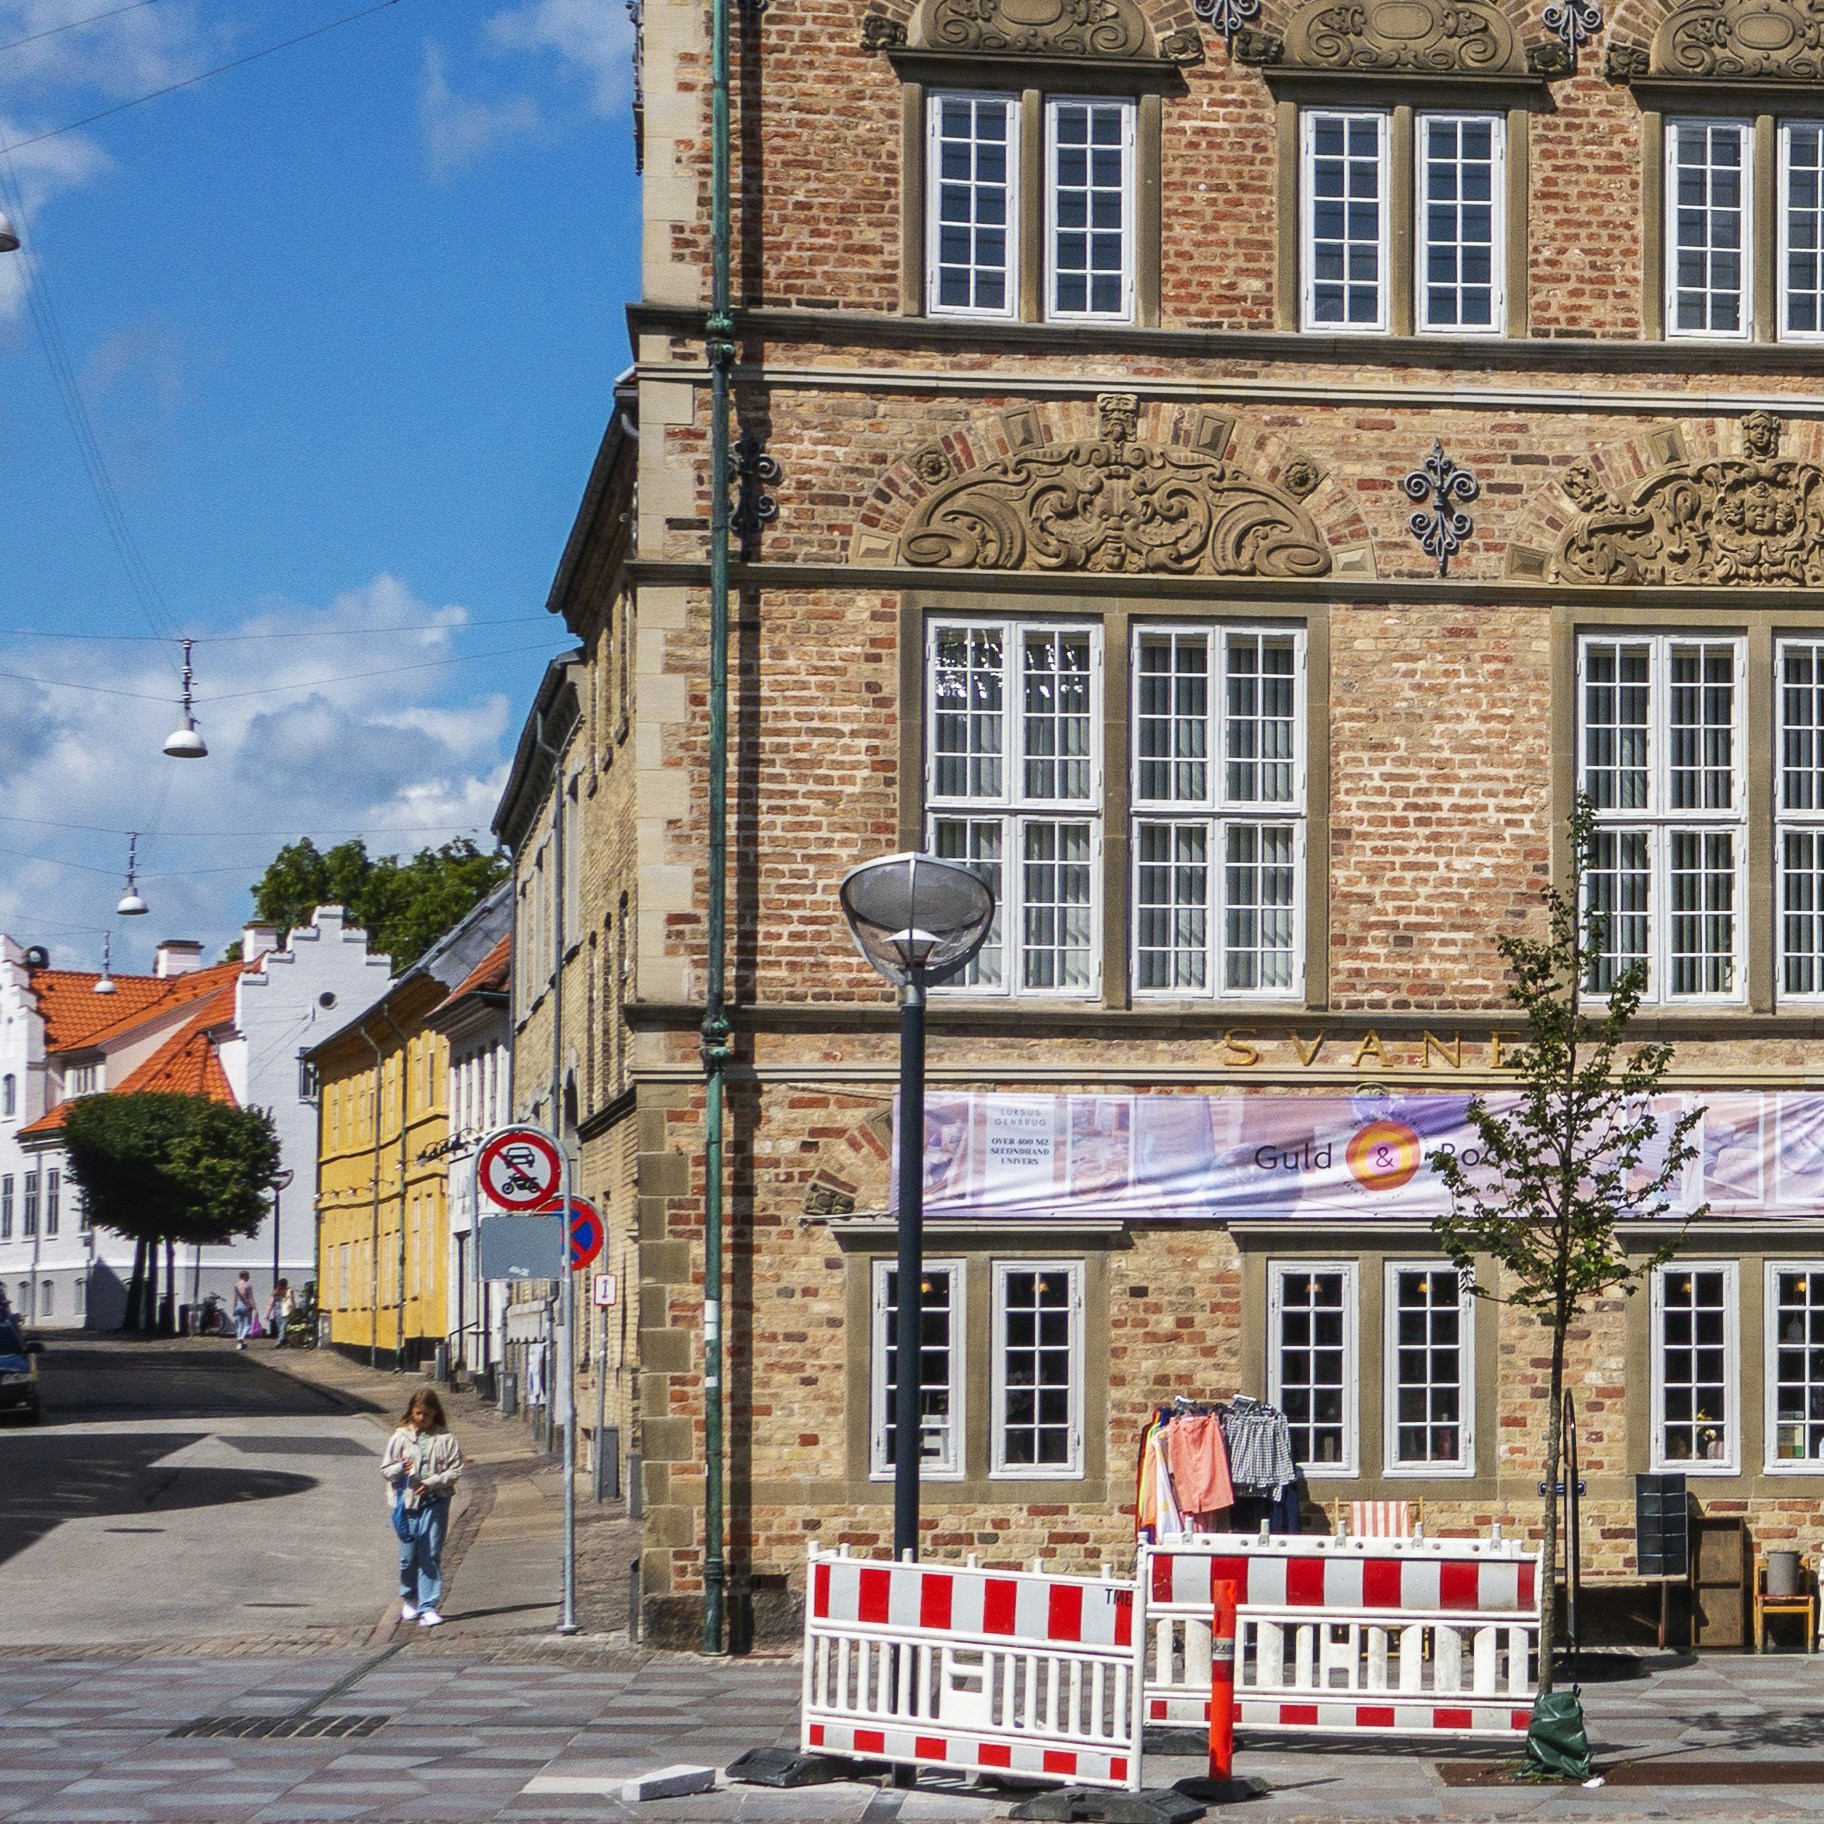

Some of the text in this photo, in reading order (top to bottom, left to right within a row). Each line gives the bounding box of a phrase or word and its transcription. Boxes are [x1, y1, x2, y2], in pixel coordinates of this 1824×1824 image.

[1223, 1029, 1525, 1069] SVANE
[990, 1147, 1050, 1156] SECONDHAND
[1254, 1142, 1332, 1170] Guld
[1376, 1146, 1394, 1168] &
[1001, 1157, 1039, 1166] UNIVERS
